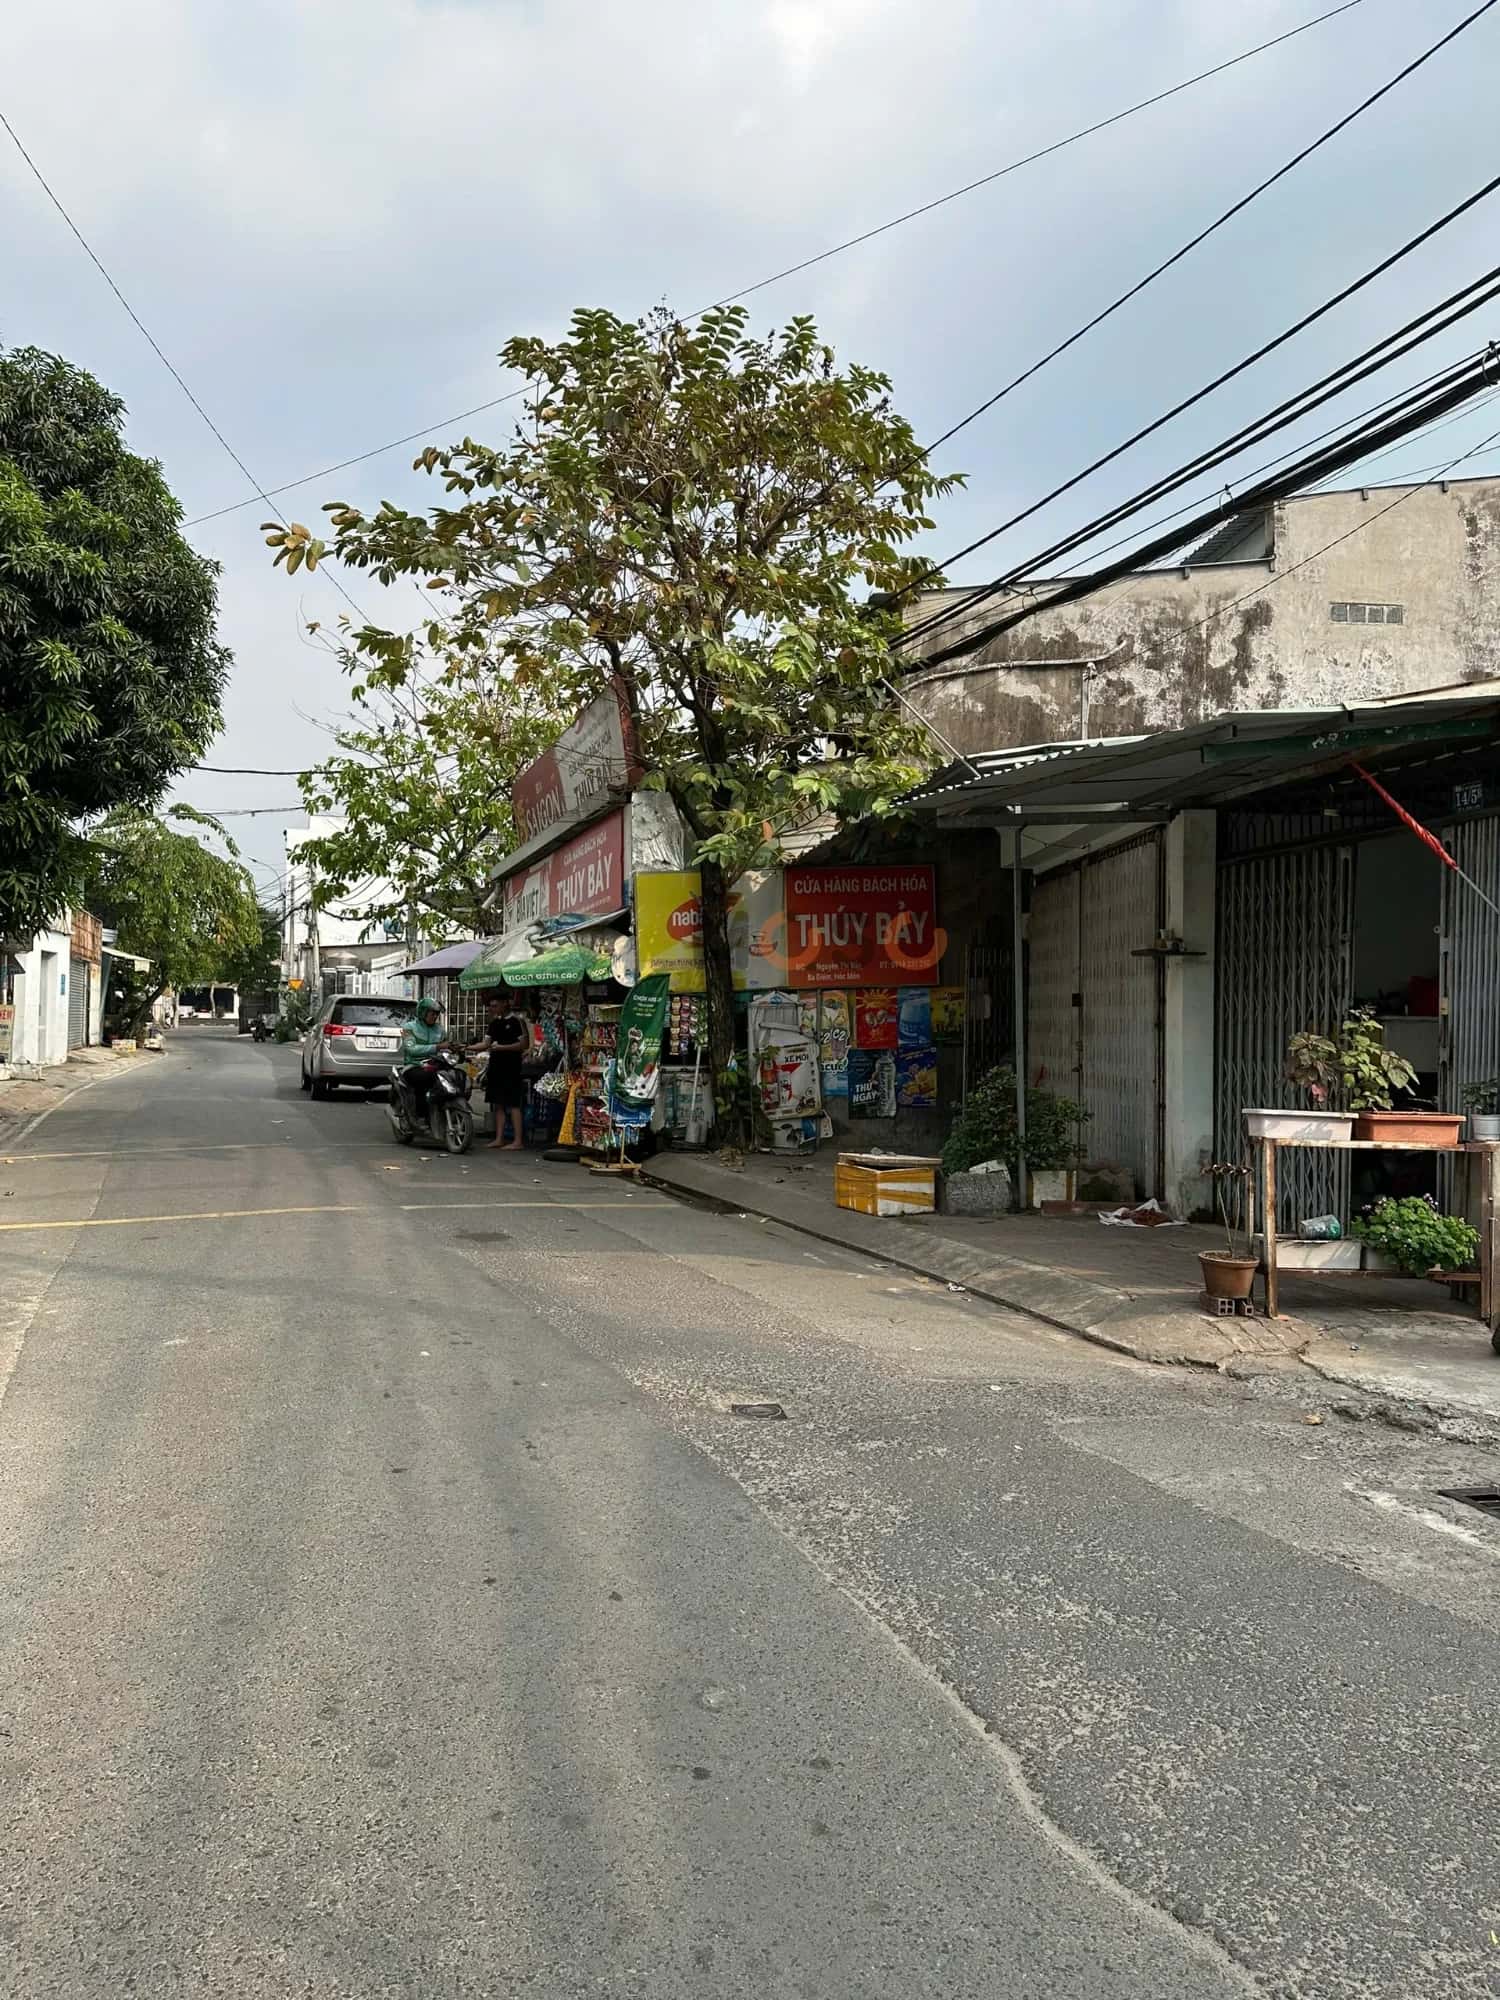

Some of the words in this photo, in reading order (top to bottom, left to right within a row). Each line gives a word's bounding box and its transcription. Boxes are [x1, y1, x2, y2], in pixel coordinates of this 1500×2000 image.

[526, 783, 566, 840] SAIGON
[557, 864, 585, 912] THÚY
[587, 849, 613, 898] BẢY
[794, 874, 822, 894] CỬA
[824, 877, 860, 893] HÀNG
[900, 873, 928, 891] HÓA
[672, 910, 704, 927] nab
[795, 905, 868, 948] THÚY
[875, 900, 929, 946] BẢY
